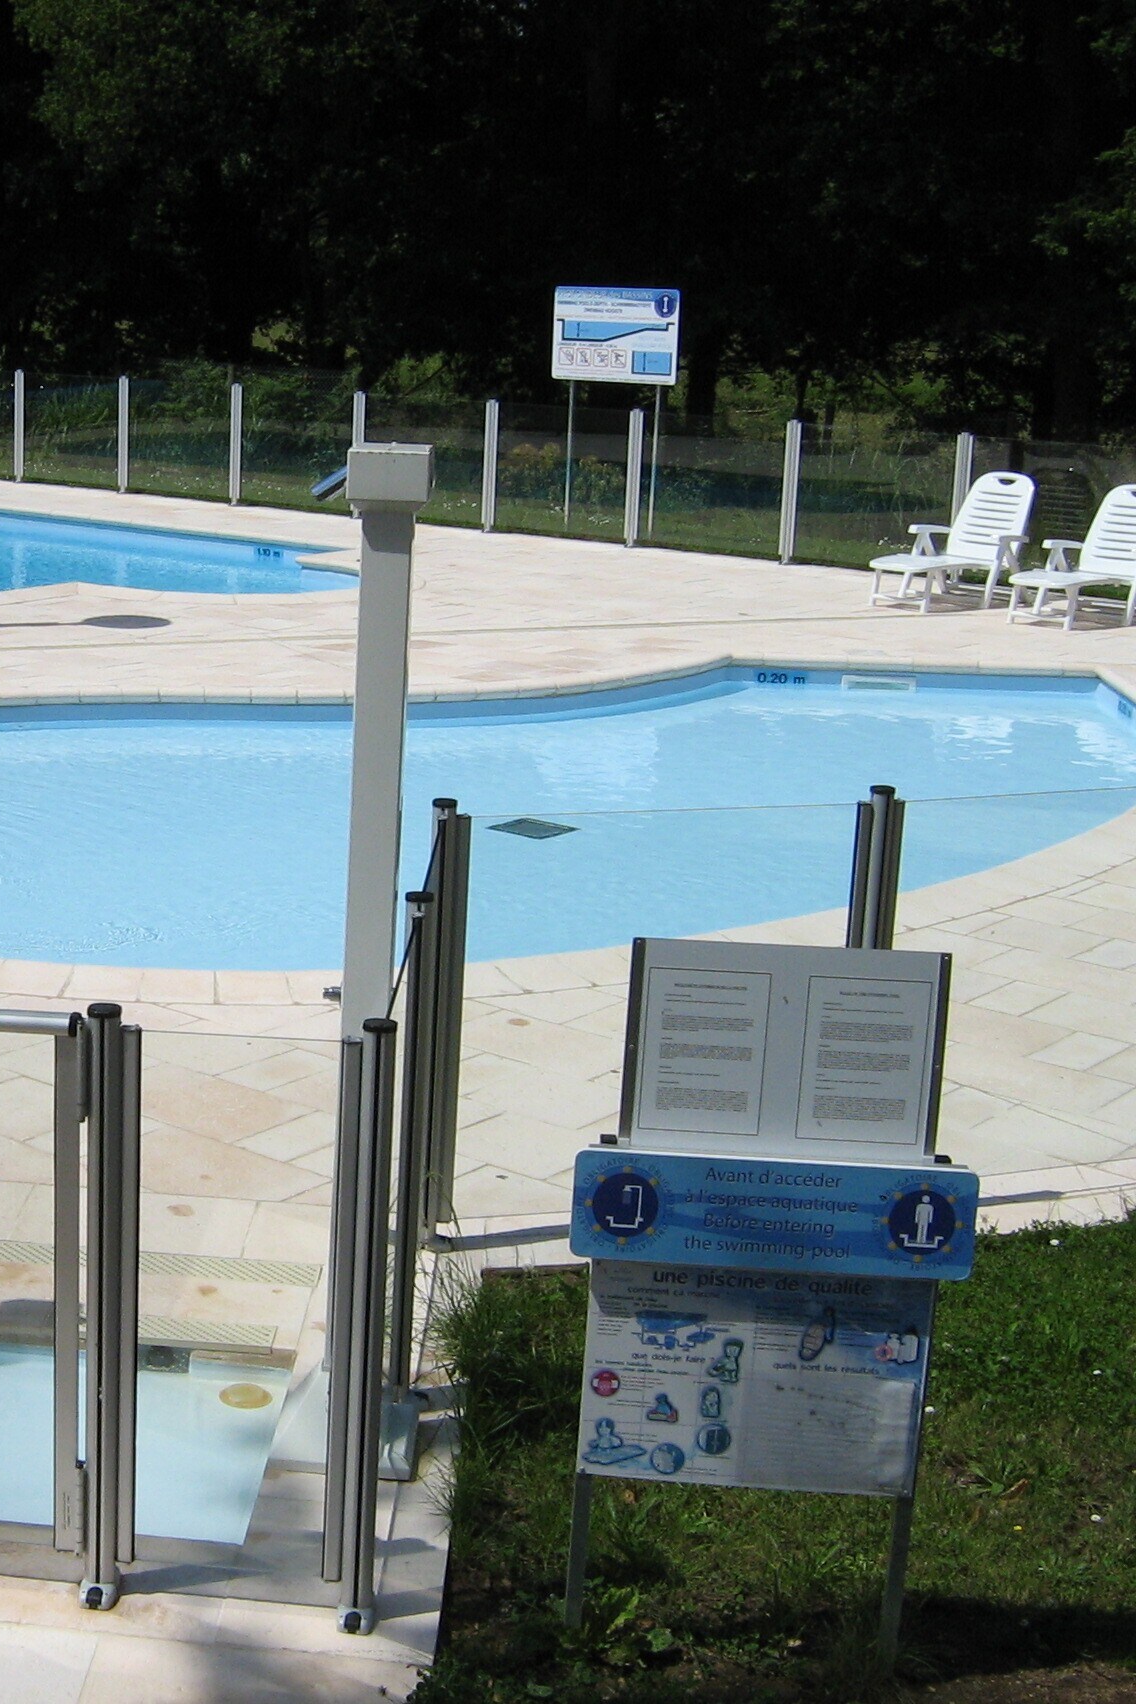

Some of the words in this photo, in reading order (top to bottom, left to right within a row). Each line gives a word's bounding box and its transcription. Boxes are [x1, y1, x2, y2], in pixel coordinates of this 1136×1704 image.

[757, 672, 788, 684] 0.20
[793, 675, 806, 685] m
[705, 1167, 753, 1184] Avant
[758, 1169, 843, 1189] d'accéder
[684, 1189, 694, 1203] à
[698, 1189, 765, 1208] l'espace
[771, 1197, 859, 1214] aquatique
[702, 1213, 759, 1231] Before
[763, 1218, 835, 1239] entering
[683, 1234, 713, 1250] the
[716, 1237, 851, 1260] swimming-pool
[652, 1270, 689, 1285] une
[696, 1269, 765, 1289] piscine
[774, 1275, 800, 1292] de
[808, 1277, 873, 1298] qualité
[773, 1361, 797, 1371] quels
[800, 1363, 821, 1372] sont
[824, 1363, 837, 1372] les
